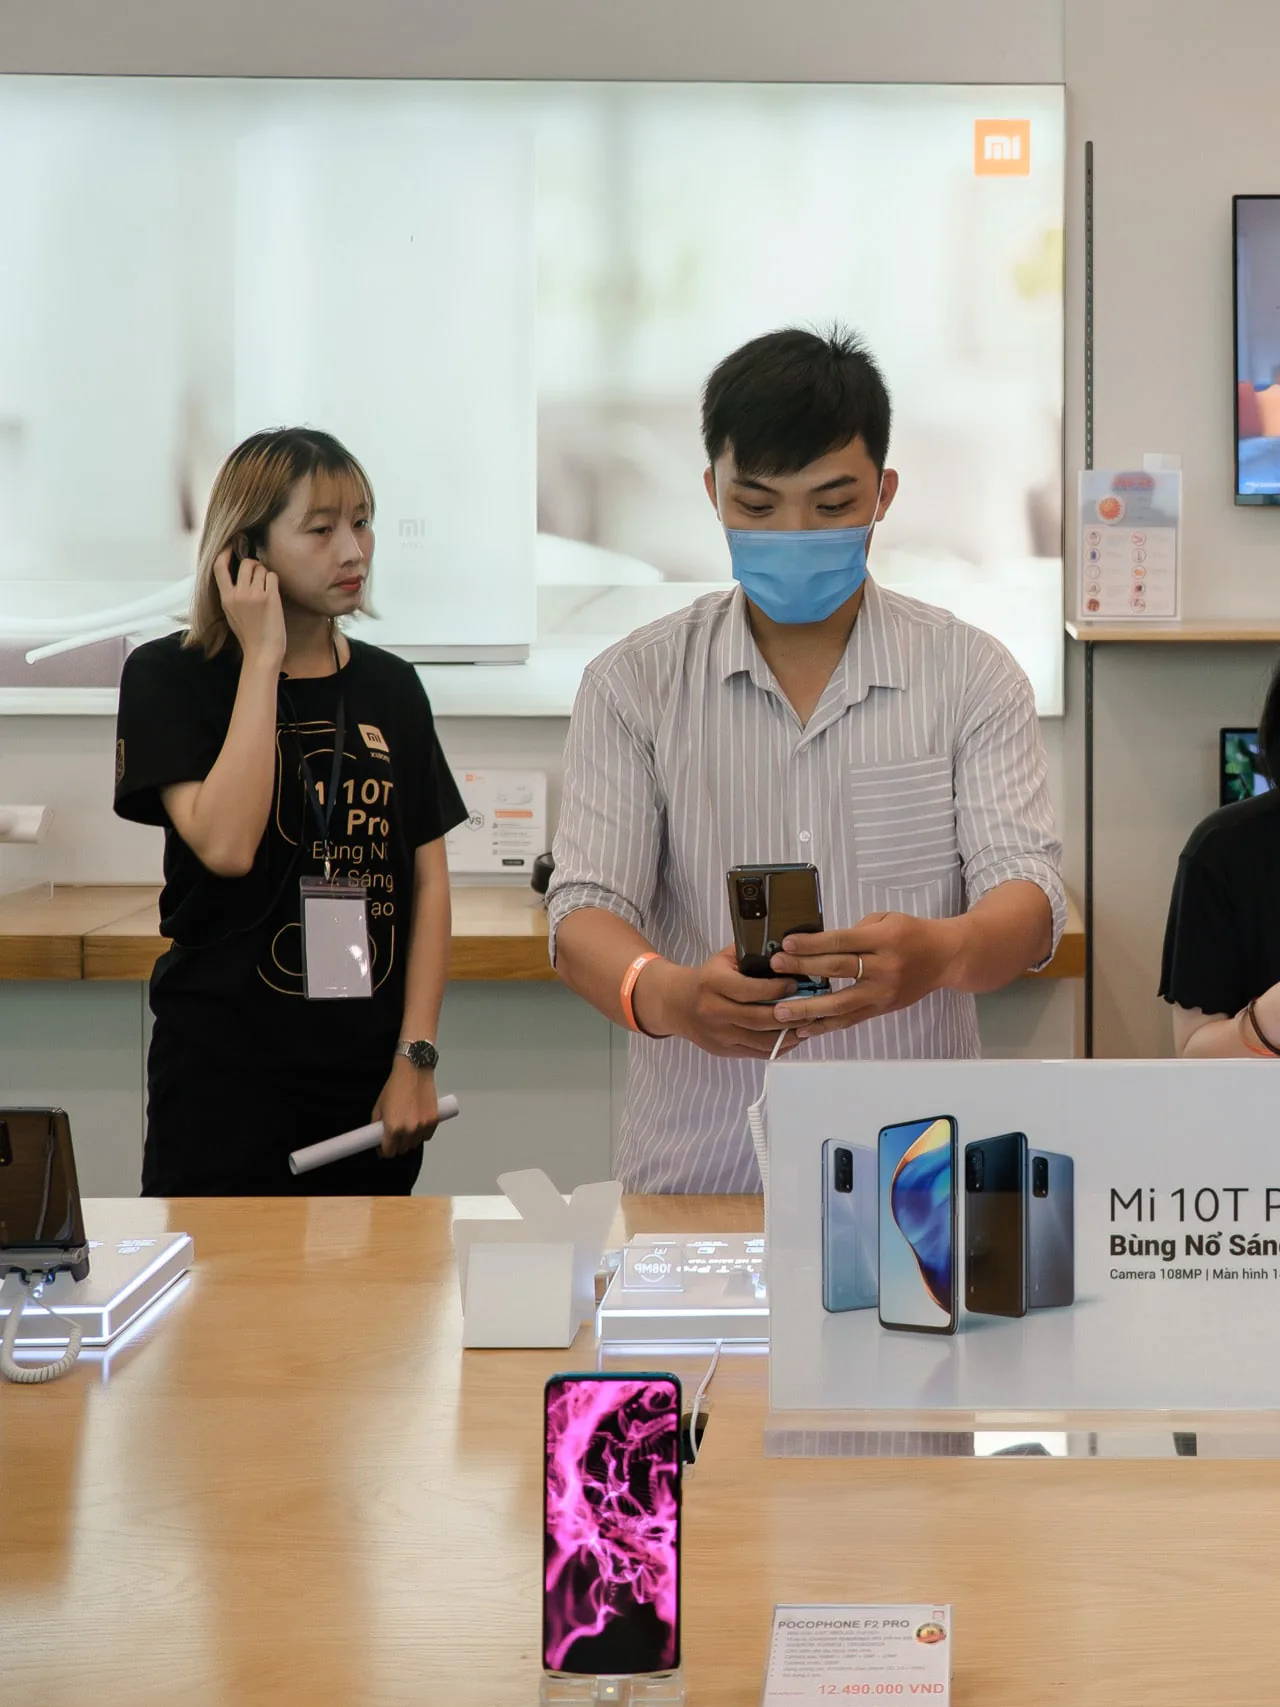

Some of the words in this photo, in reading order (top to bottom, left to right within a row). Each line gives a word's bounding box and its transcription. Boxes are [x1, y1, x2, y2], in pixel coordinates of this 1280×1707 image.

[346, 808, 390, 837] Pro
[347, 868, 395, 893] Sáng
[1110, 1187, 1155, 1222] Mi
[1170, 1187, 1249, 1222] 10T
[1110, 1234, 1176, 1262] Bùng
[1185, 1231, 1223, 1256] Nổ
[1110, 1268, 1156, 1280] Camera
[1160, 1268, 1202, 1280] 108MP
[1212, 1267, 1238, 1280] Màn
[1242, 1268, 1269, 1280] hình
[778, 1620, 860, 1629] POCOPHONE
[864, 1620, 879, 1629] F2
[883, 1620, 910, 1628] PRO
[819, 1684, 904, 1695] 12.490.000
[909, 1683, 945, 1694] VND
